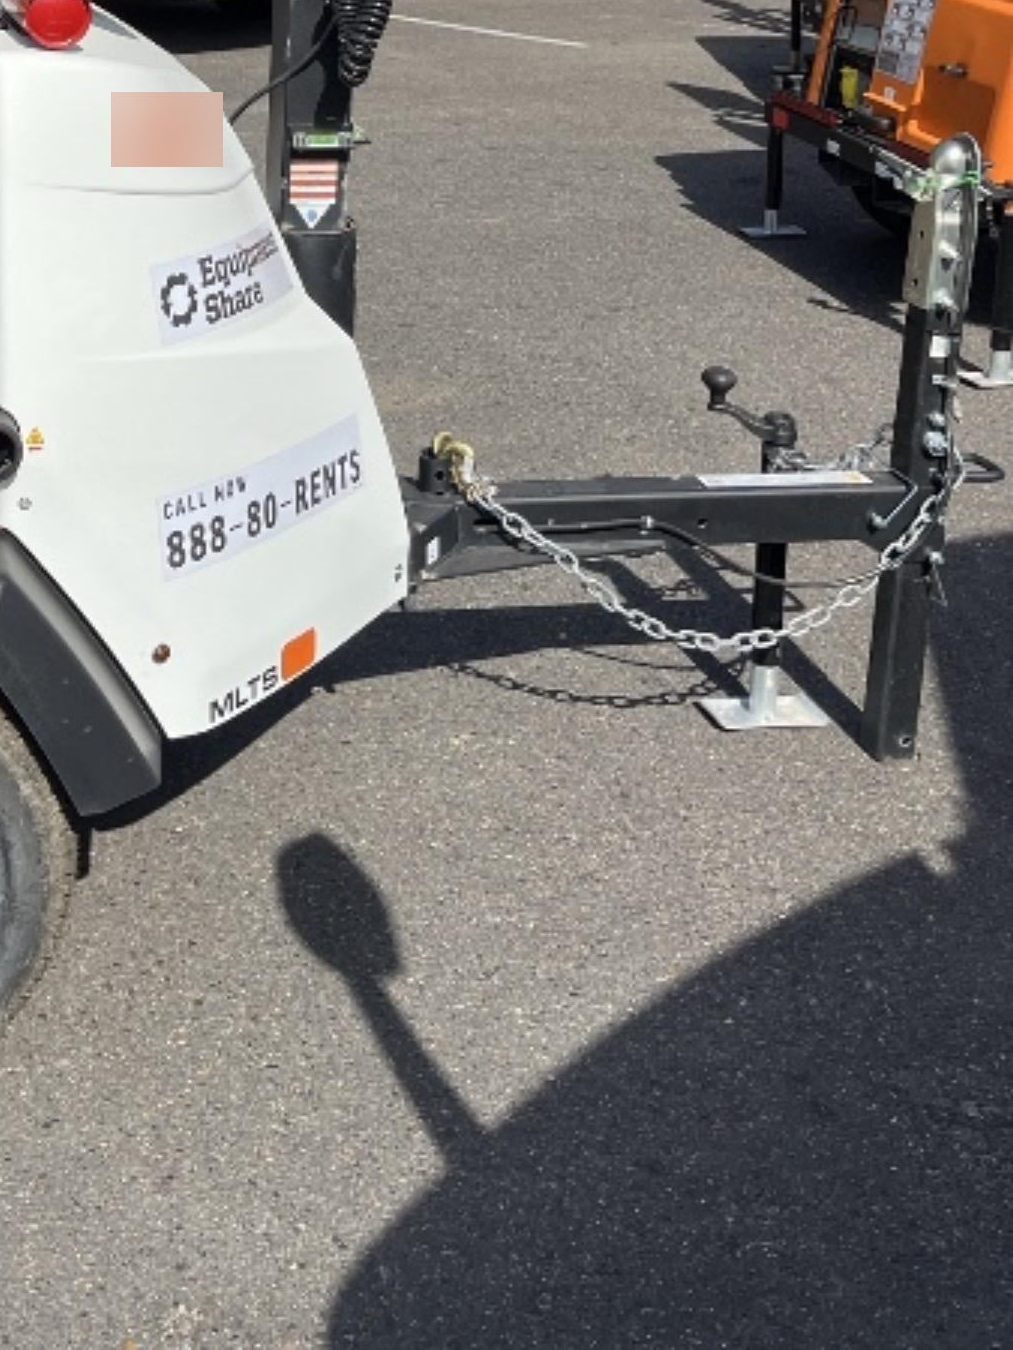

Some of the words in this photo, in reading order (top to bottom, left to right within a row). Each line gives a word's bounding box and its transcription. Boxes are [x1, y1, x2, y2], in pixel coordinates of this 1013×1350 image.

[205, 281, 264, 325] Share
[163, 491, 207, 520] CALL
[166, 449, 361, 569] 888-80-RENTS
[209, 664, 278, 724] MLTS
